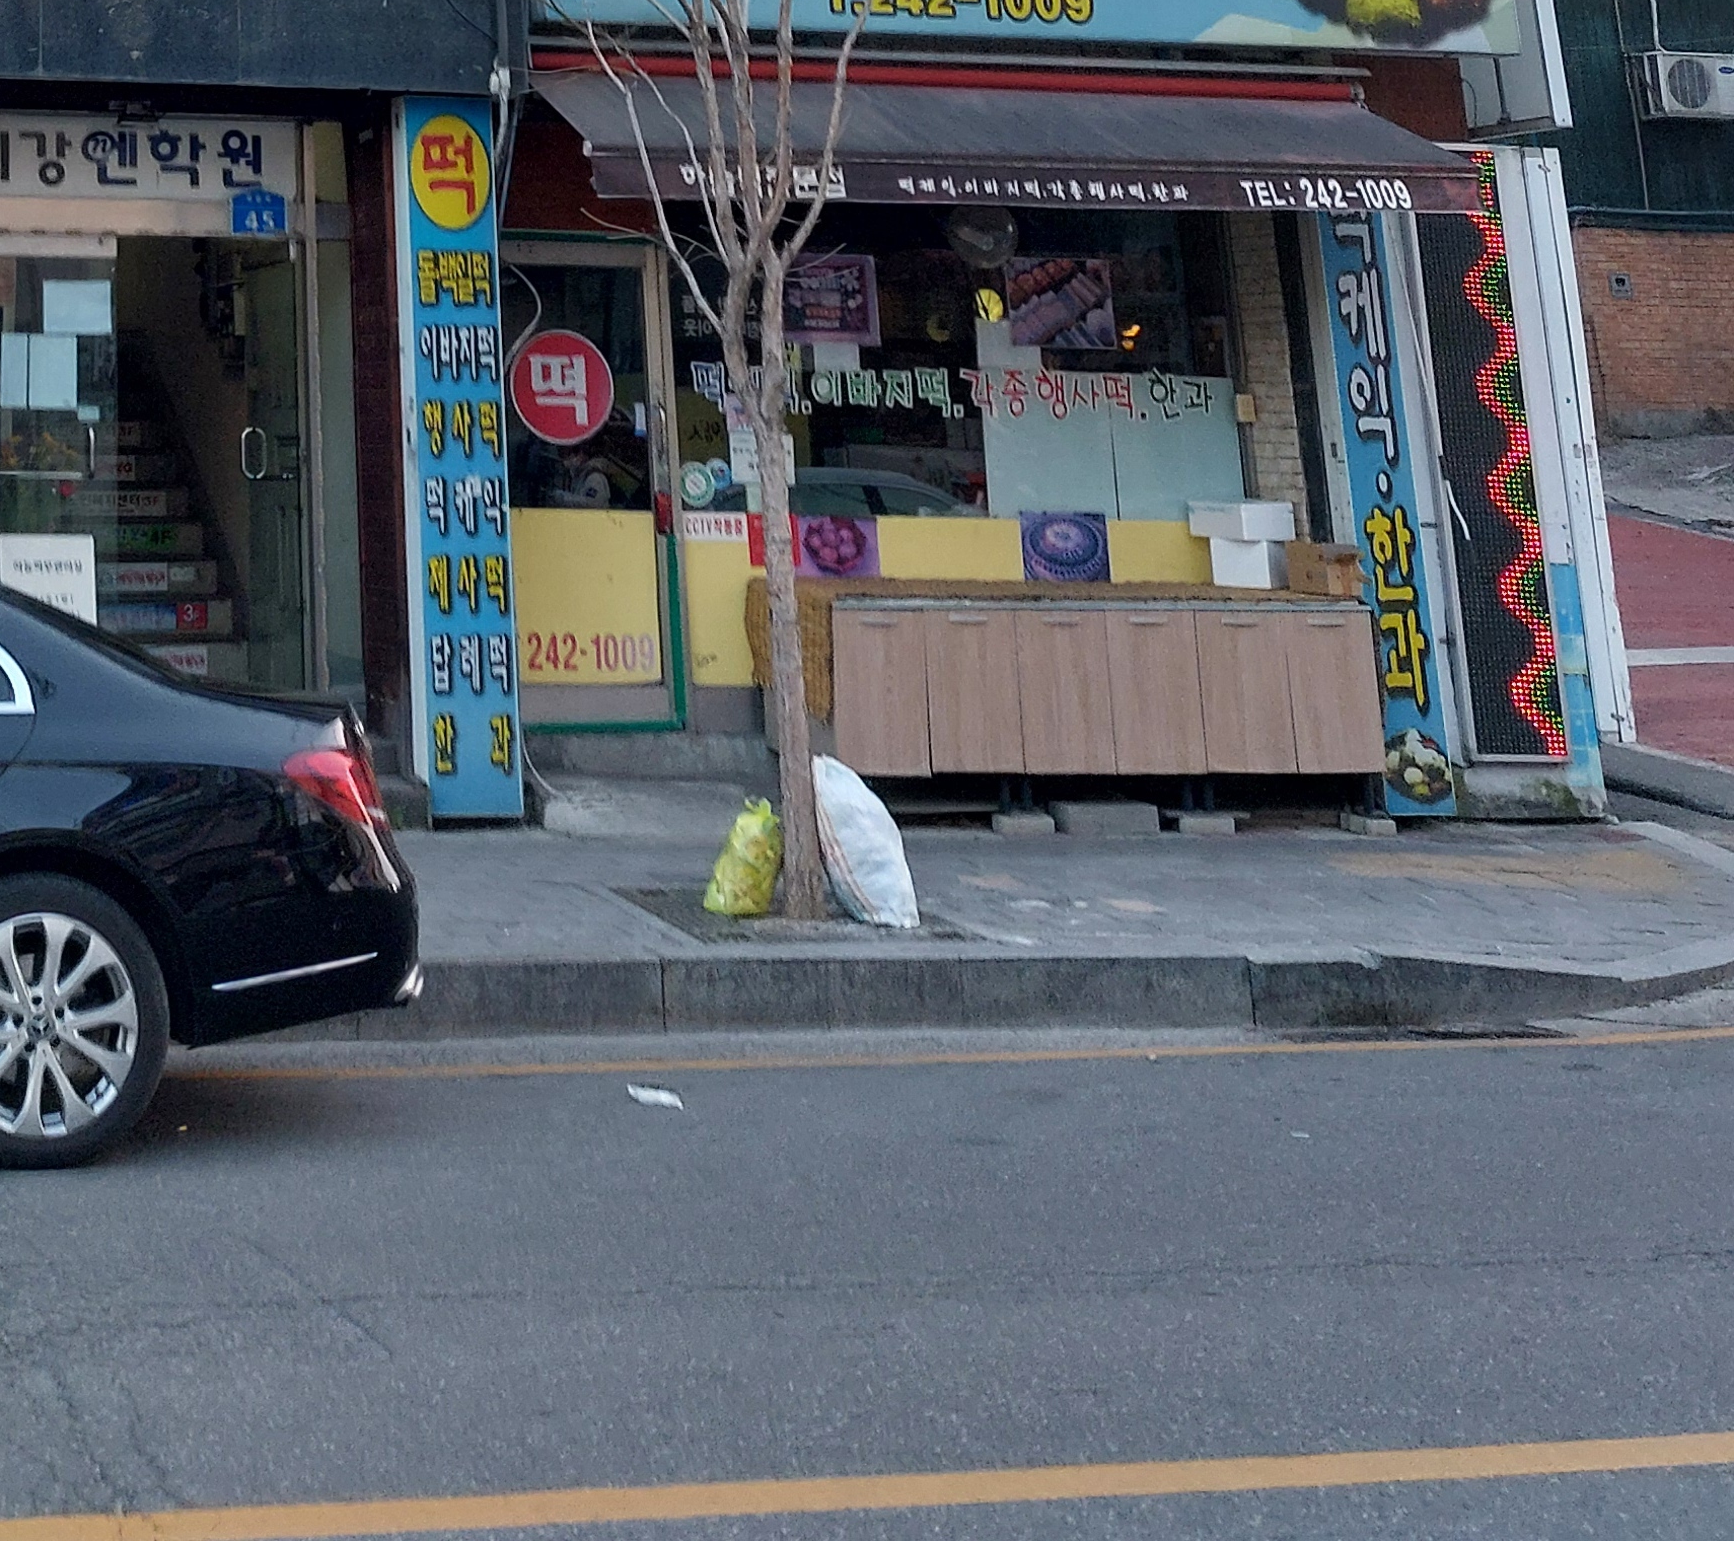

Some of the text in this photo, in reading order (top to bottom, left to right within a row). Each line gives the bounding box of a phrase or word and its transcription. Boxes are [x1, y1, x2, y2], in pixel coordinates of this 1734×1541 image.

[420, 132, 476, 216] 떡
[1298, 176, 1414, 210] 242-1009
[528, 353, 589, 427] 떡
